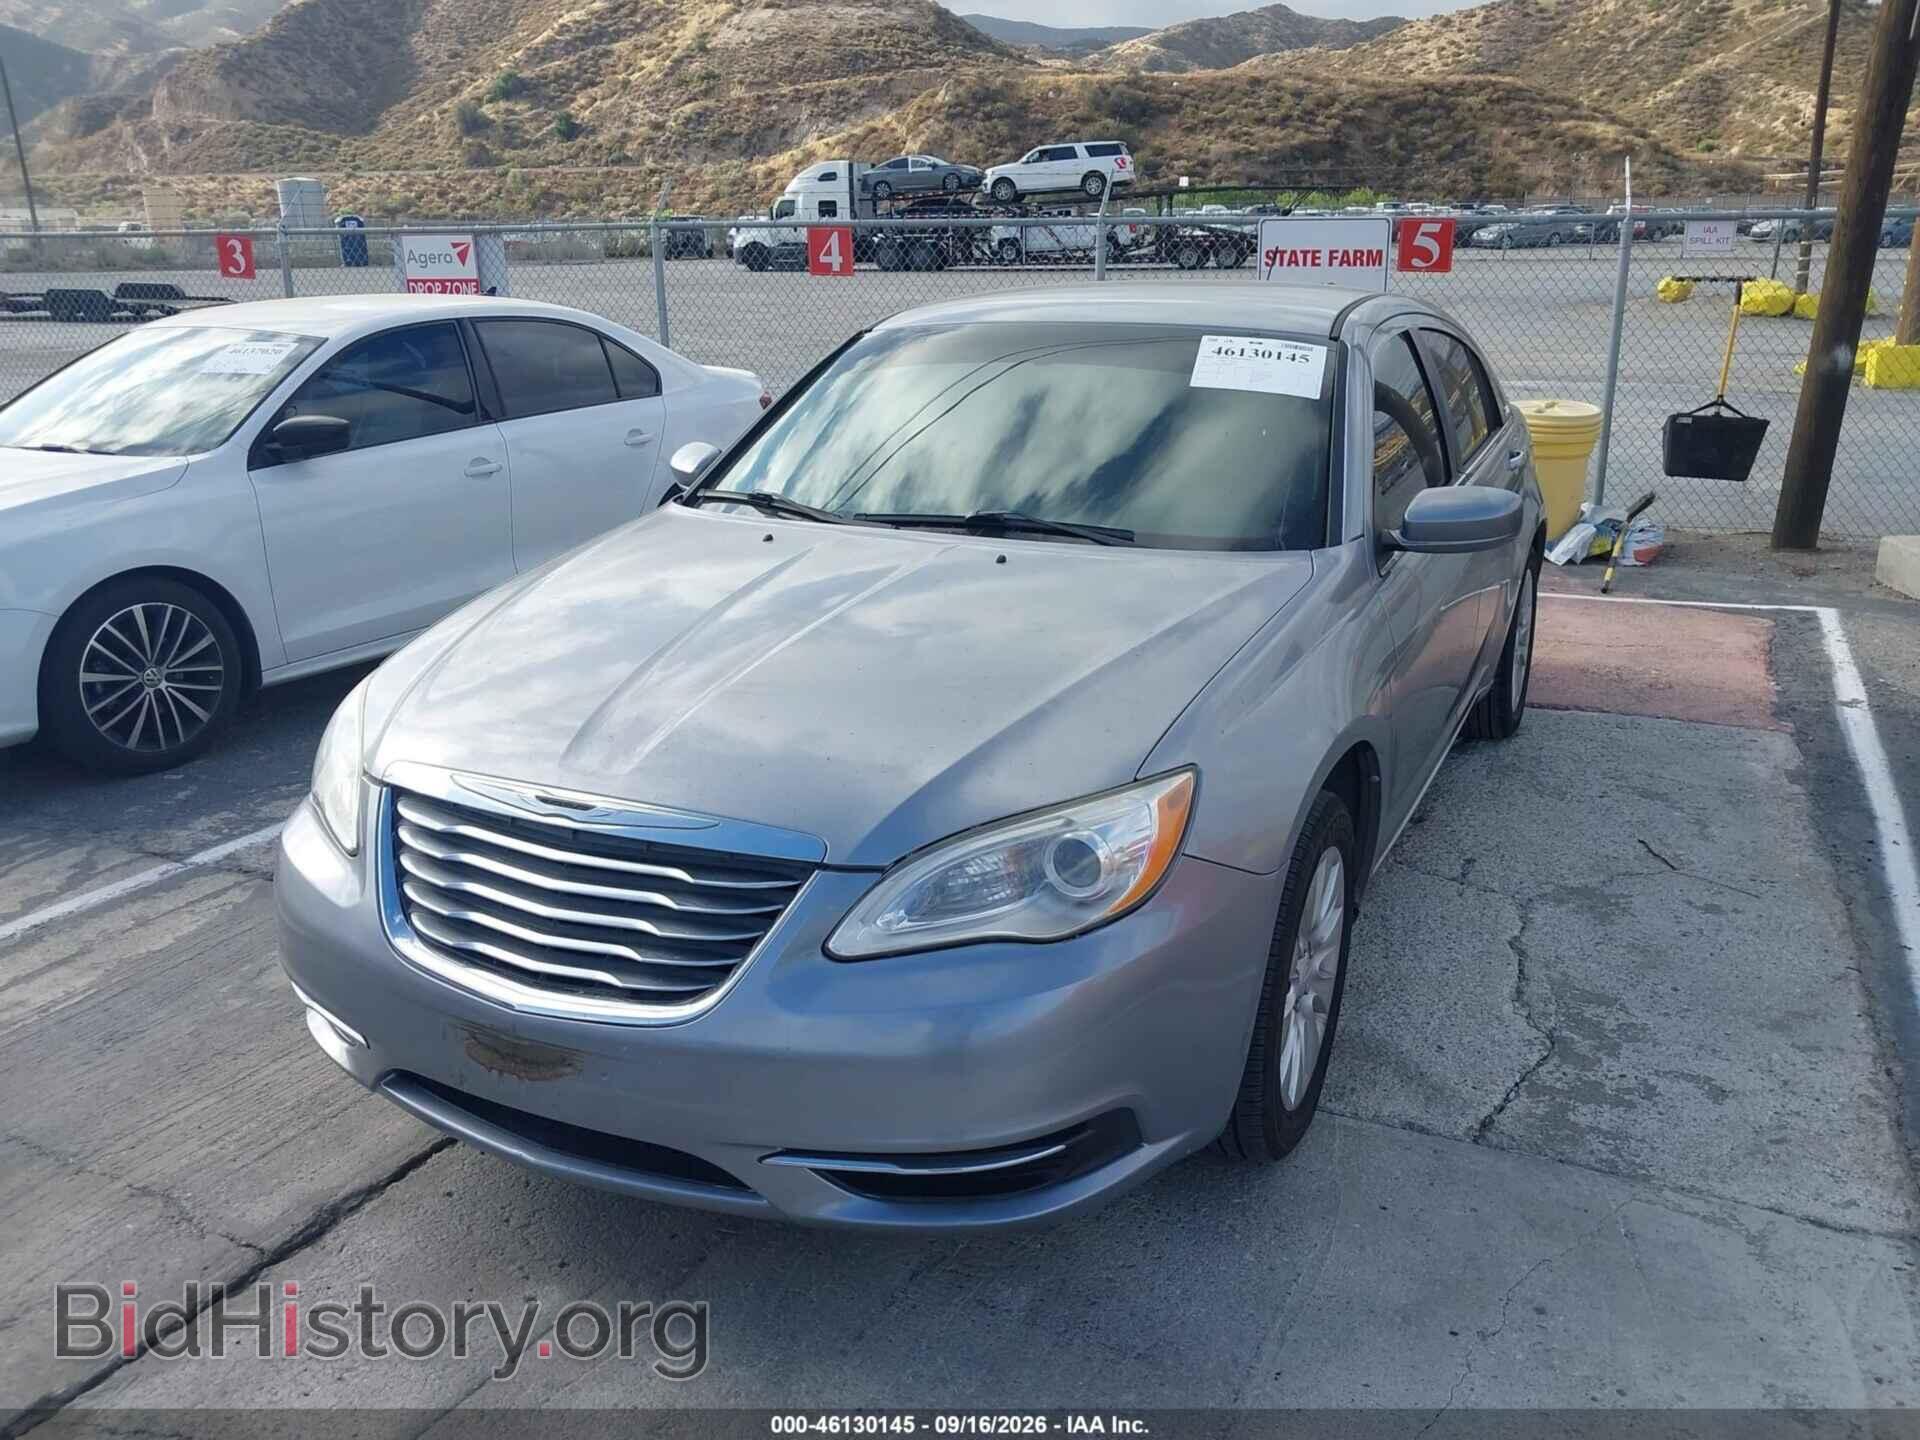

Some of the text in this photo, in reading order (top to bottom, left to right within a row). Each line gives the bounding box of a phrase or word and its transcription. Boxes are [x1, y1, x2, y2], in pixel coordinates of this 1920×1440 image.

[1703, 225, 1718, 233] IAA
[1411, 223, 1442, 267] 5
[1689, 236, 1730, 245] SPILL KIT
[226, 238, 246, 274] 3
[407, 249, 453, 268] Agero
[819, 231, 843, 272] 4
[1264, 249, 1383, 267] STATE FARM
[409, 282, 478, 295] DROP ZONE
[1211, 346, 1312, 364] 46130145
